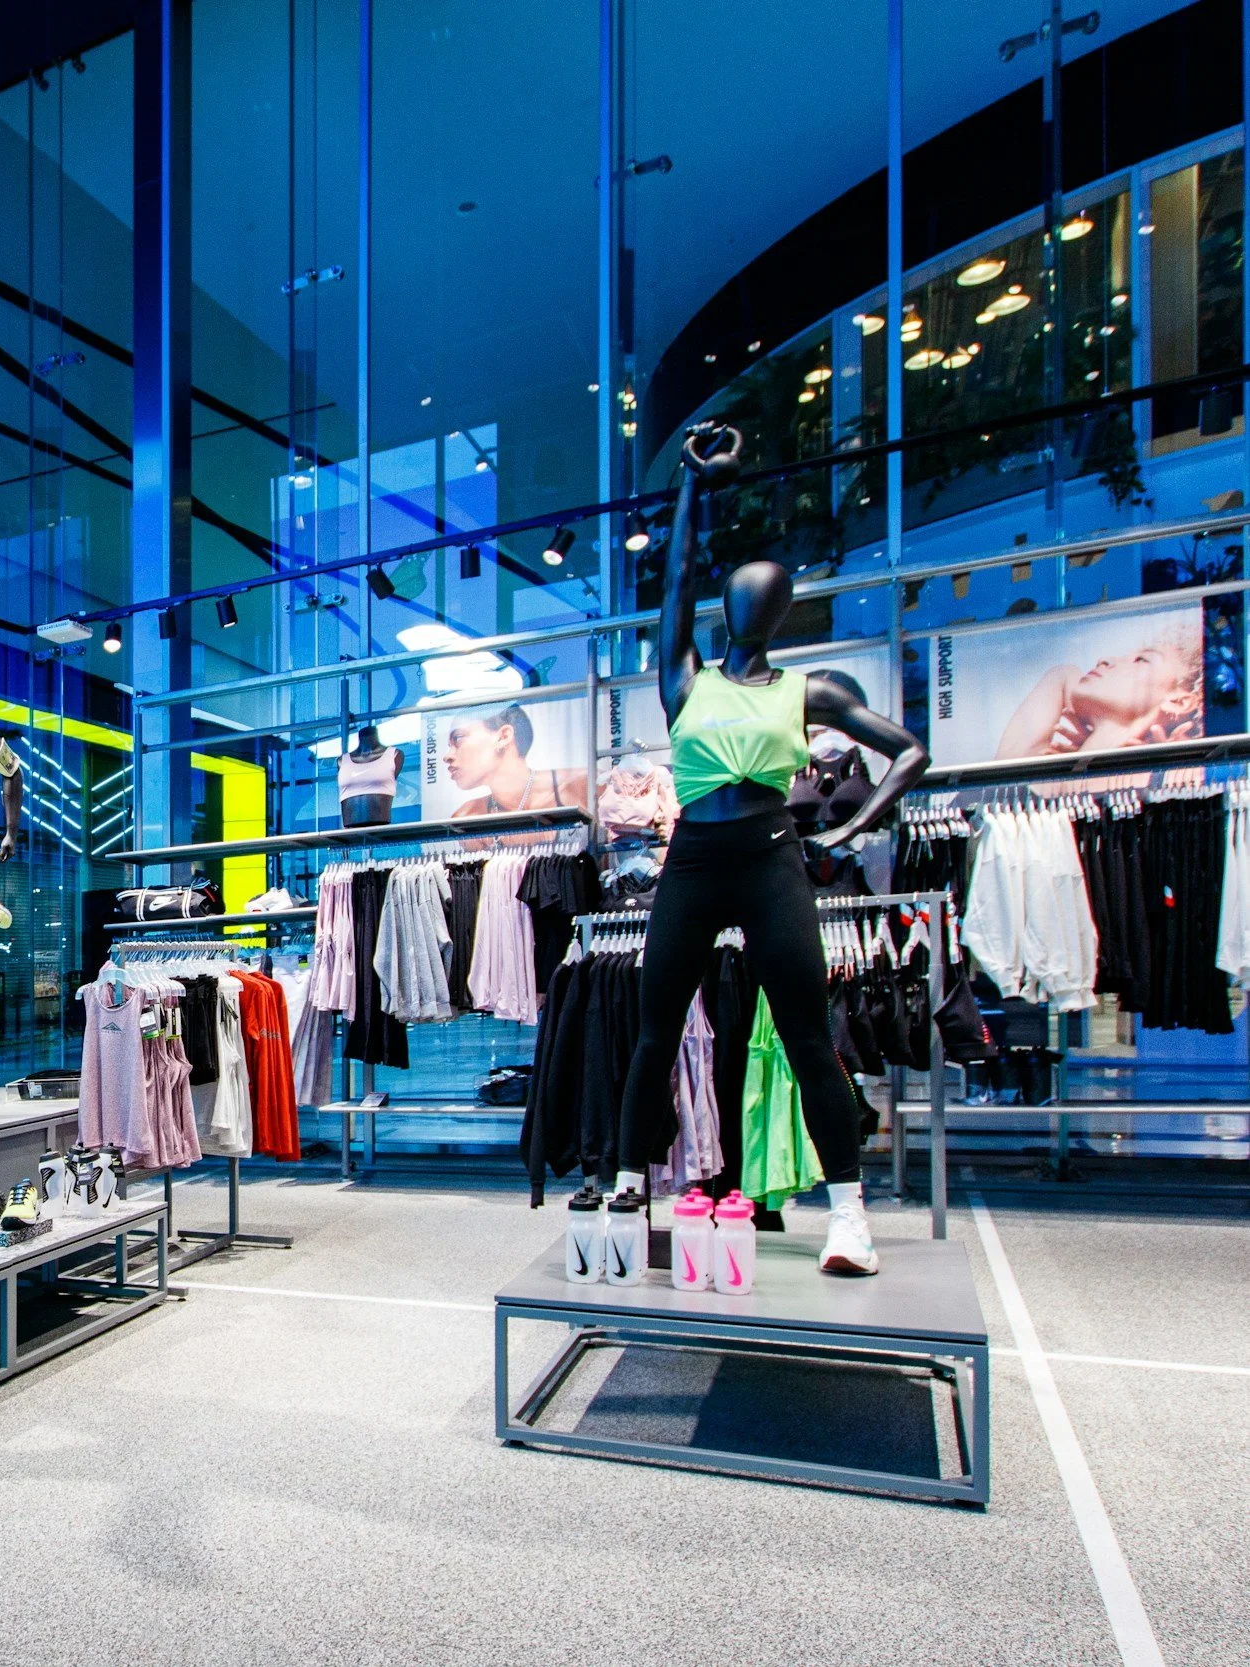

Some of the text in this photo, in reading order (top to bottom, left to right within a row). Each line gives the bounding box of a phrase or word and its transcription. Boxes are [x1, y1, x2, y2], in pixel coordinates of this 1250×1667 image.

[938, 635, 953, 719] HIGH SUPPORT
[610, 688, 621, 735] SUPPORT
[427, 757, 437, 784] LIGHT
